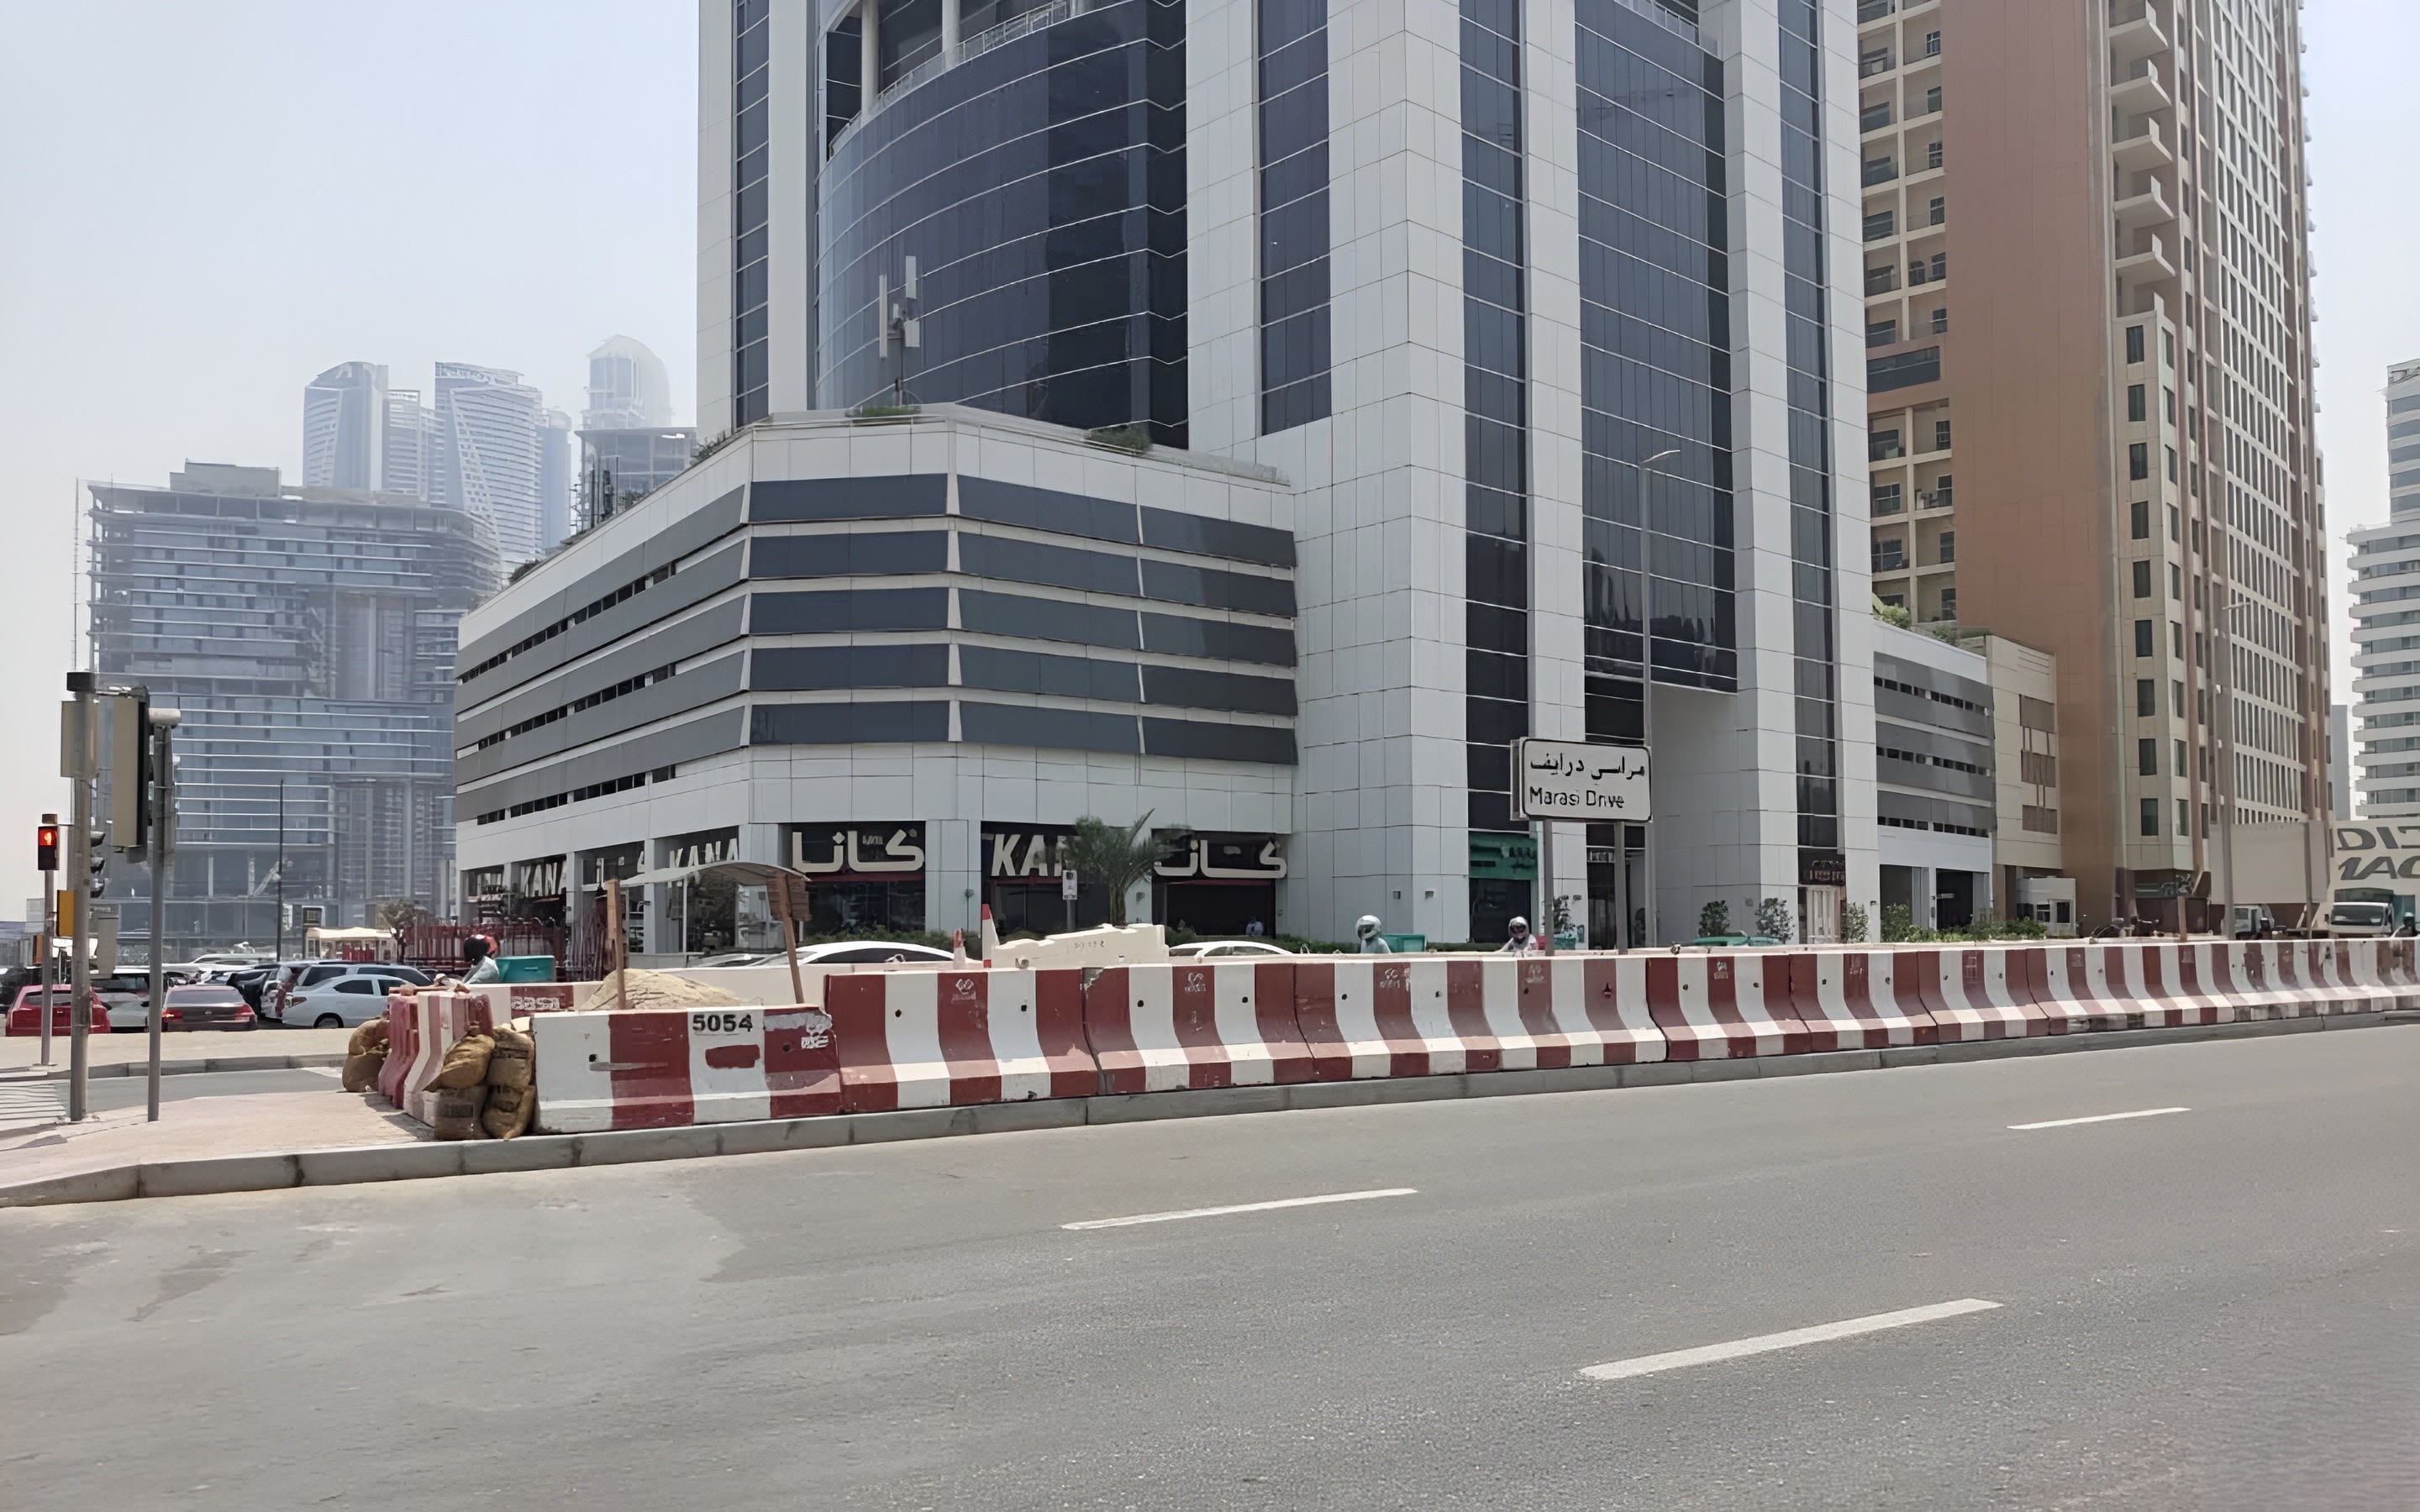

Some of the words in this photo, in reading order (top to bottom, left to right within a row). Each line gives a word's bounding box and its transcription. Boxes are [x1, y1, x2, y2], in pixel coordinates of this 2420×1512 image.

[1586, 790, 1624, 809] Drive
[792, 828, 924, 873] كانا
[692, 1014, 753, 1032] 5054
